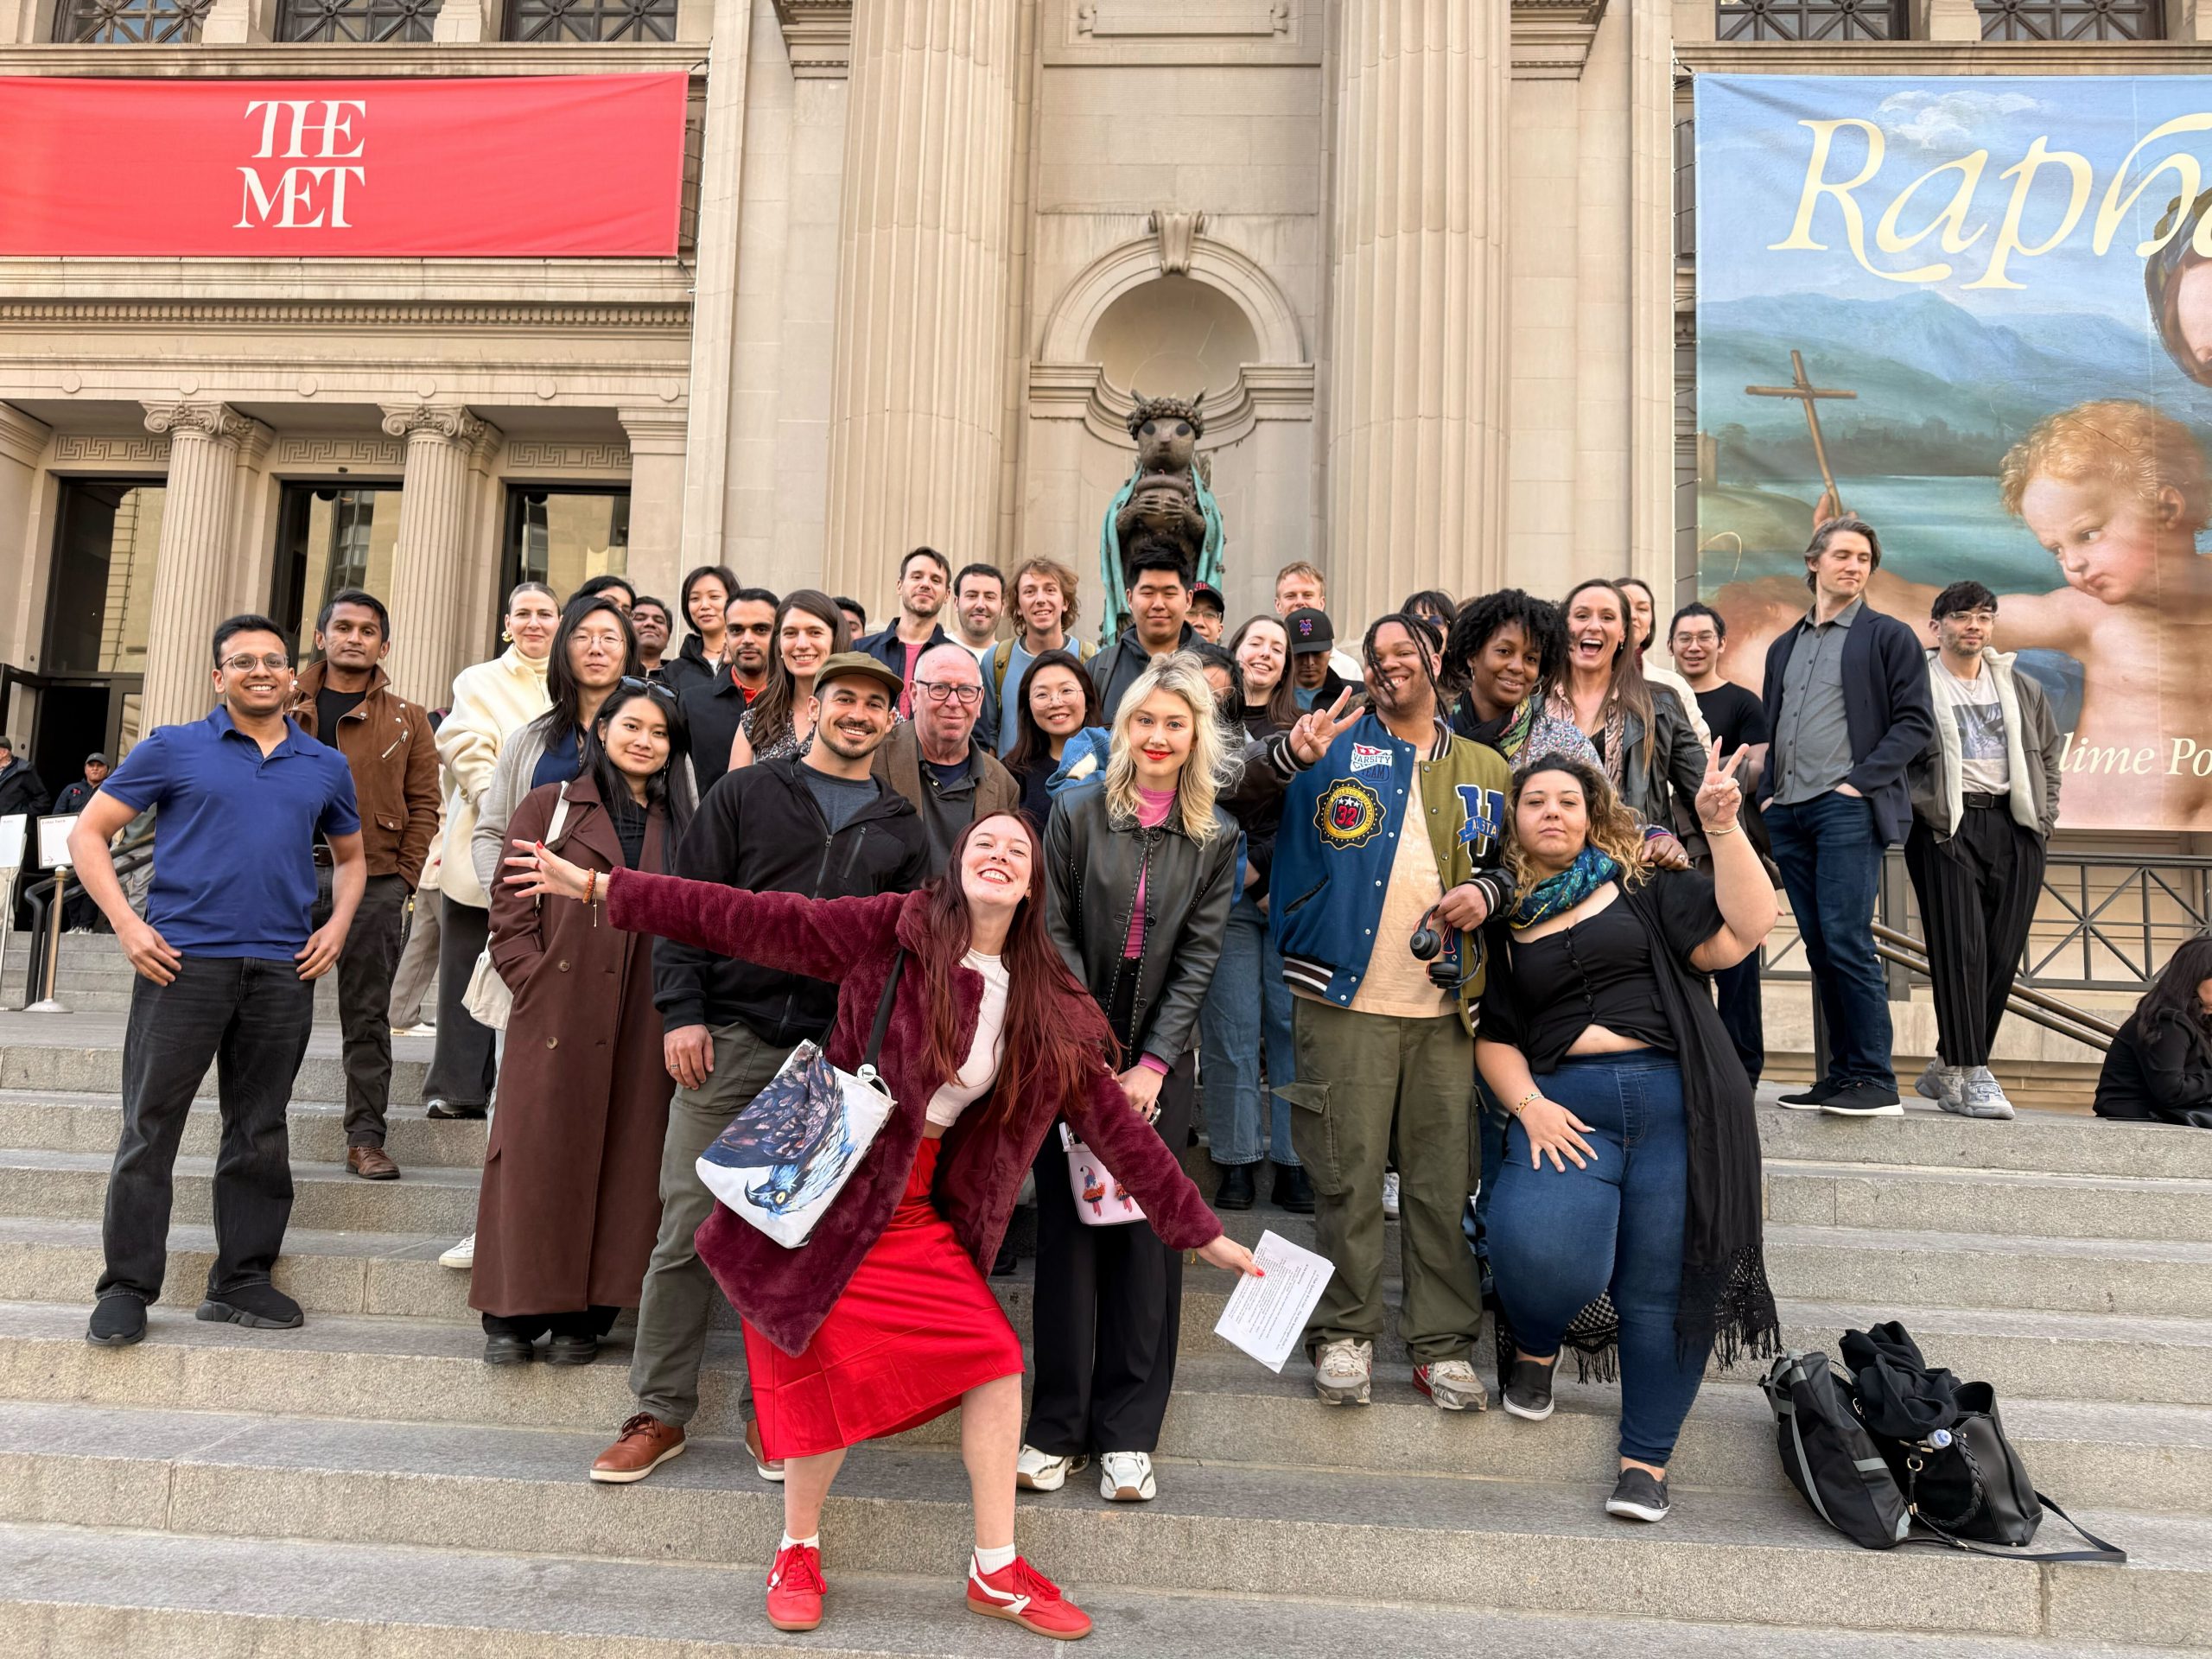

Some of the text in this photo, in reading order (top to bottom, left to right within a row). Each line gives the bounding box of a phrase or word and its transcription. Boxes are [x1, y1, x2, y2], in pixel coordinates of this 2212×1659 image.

[245, 100, 365, 158] THE
[232, 166, 365, 228] MET
[1767, 112, 2212, 289] Raph
[1353, 753, 1390, 764] VARSITY
[1335, 805, 1357, 827] 32
[1482, 820, 1497, 836] STA
